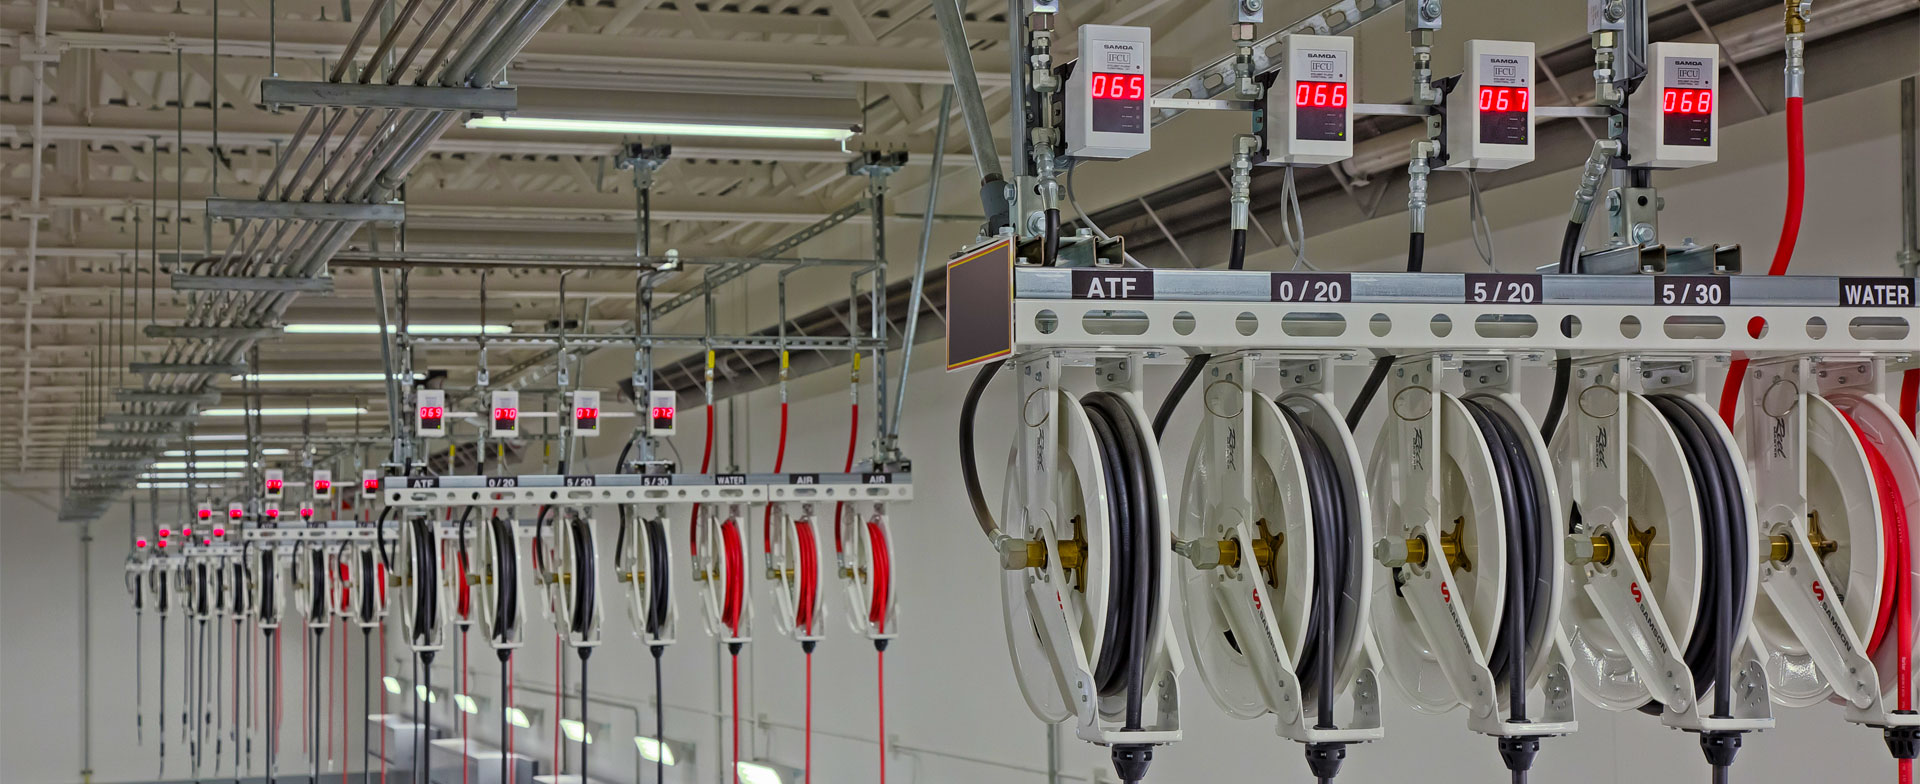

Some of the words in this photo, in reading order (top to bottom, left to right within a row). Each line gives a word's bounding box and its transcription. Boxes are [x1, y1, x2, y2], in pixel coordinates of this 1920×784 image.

[1108, 54, 1129, 62] IFCU
[1312, 62, 1332, 71] IFCU
[1495, 67, 1514, 76] IFCU
[1679, 69, 1698, 77] IFCU
[1092, 75, 1141, 98] 065
[1296, 84, 1345, 106] 066
[1480, 89, 1527, 110] 067
[1663, 91, 1711, 112] 068
[1087, 277, 1136, 298] ATF
[1844, 285, 1909, 305] WATER
[421, 409, 442, 417] 069
[495, 409, 516, 418] 070
[577, 408, 598, 417] 071
[653, 408, 673, 417] 072
[1775, 416, 1786, 458] Reel
[1597, 425, 1607, 468] Reel
[413, 479, 434, 488] ATF
[717, 476, 744, 485] WATER
[796, 475, 813, 485] AIR
[869, 475, 886, 485] AIR
[1640, 603, 1667, 654] SAMSON
[1822, 602, 1852, 652] SAMSON
